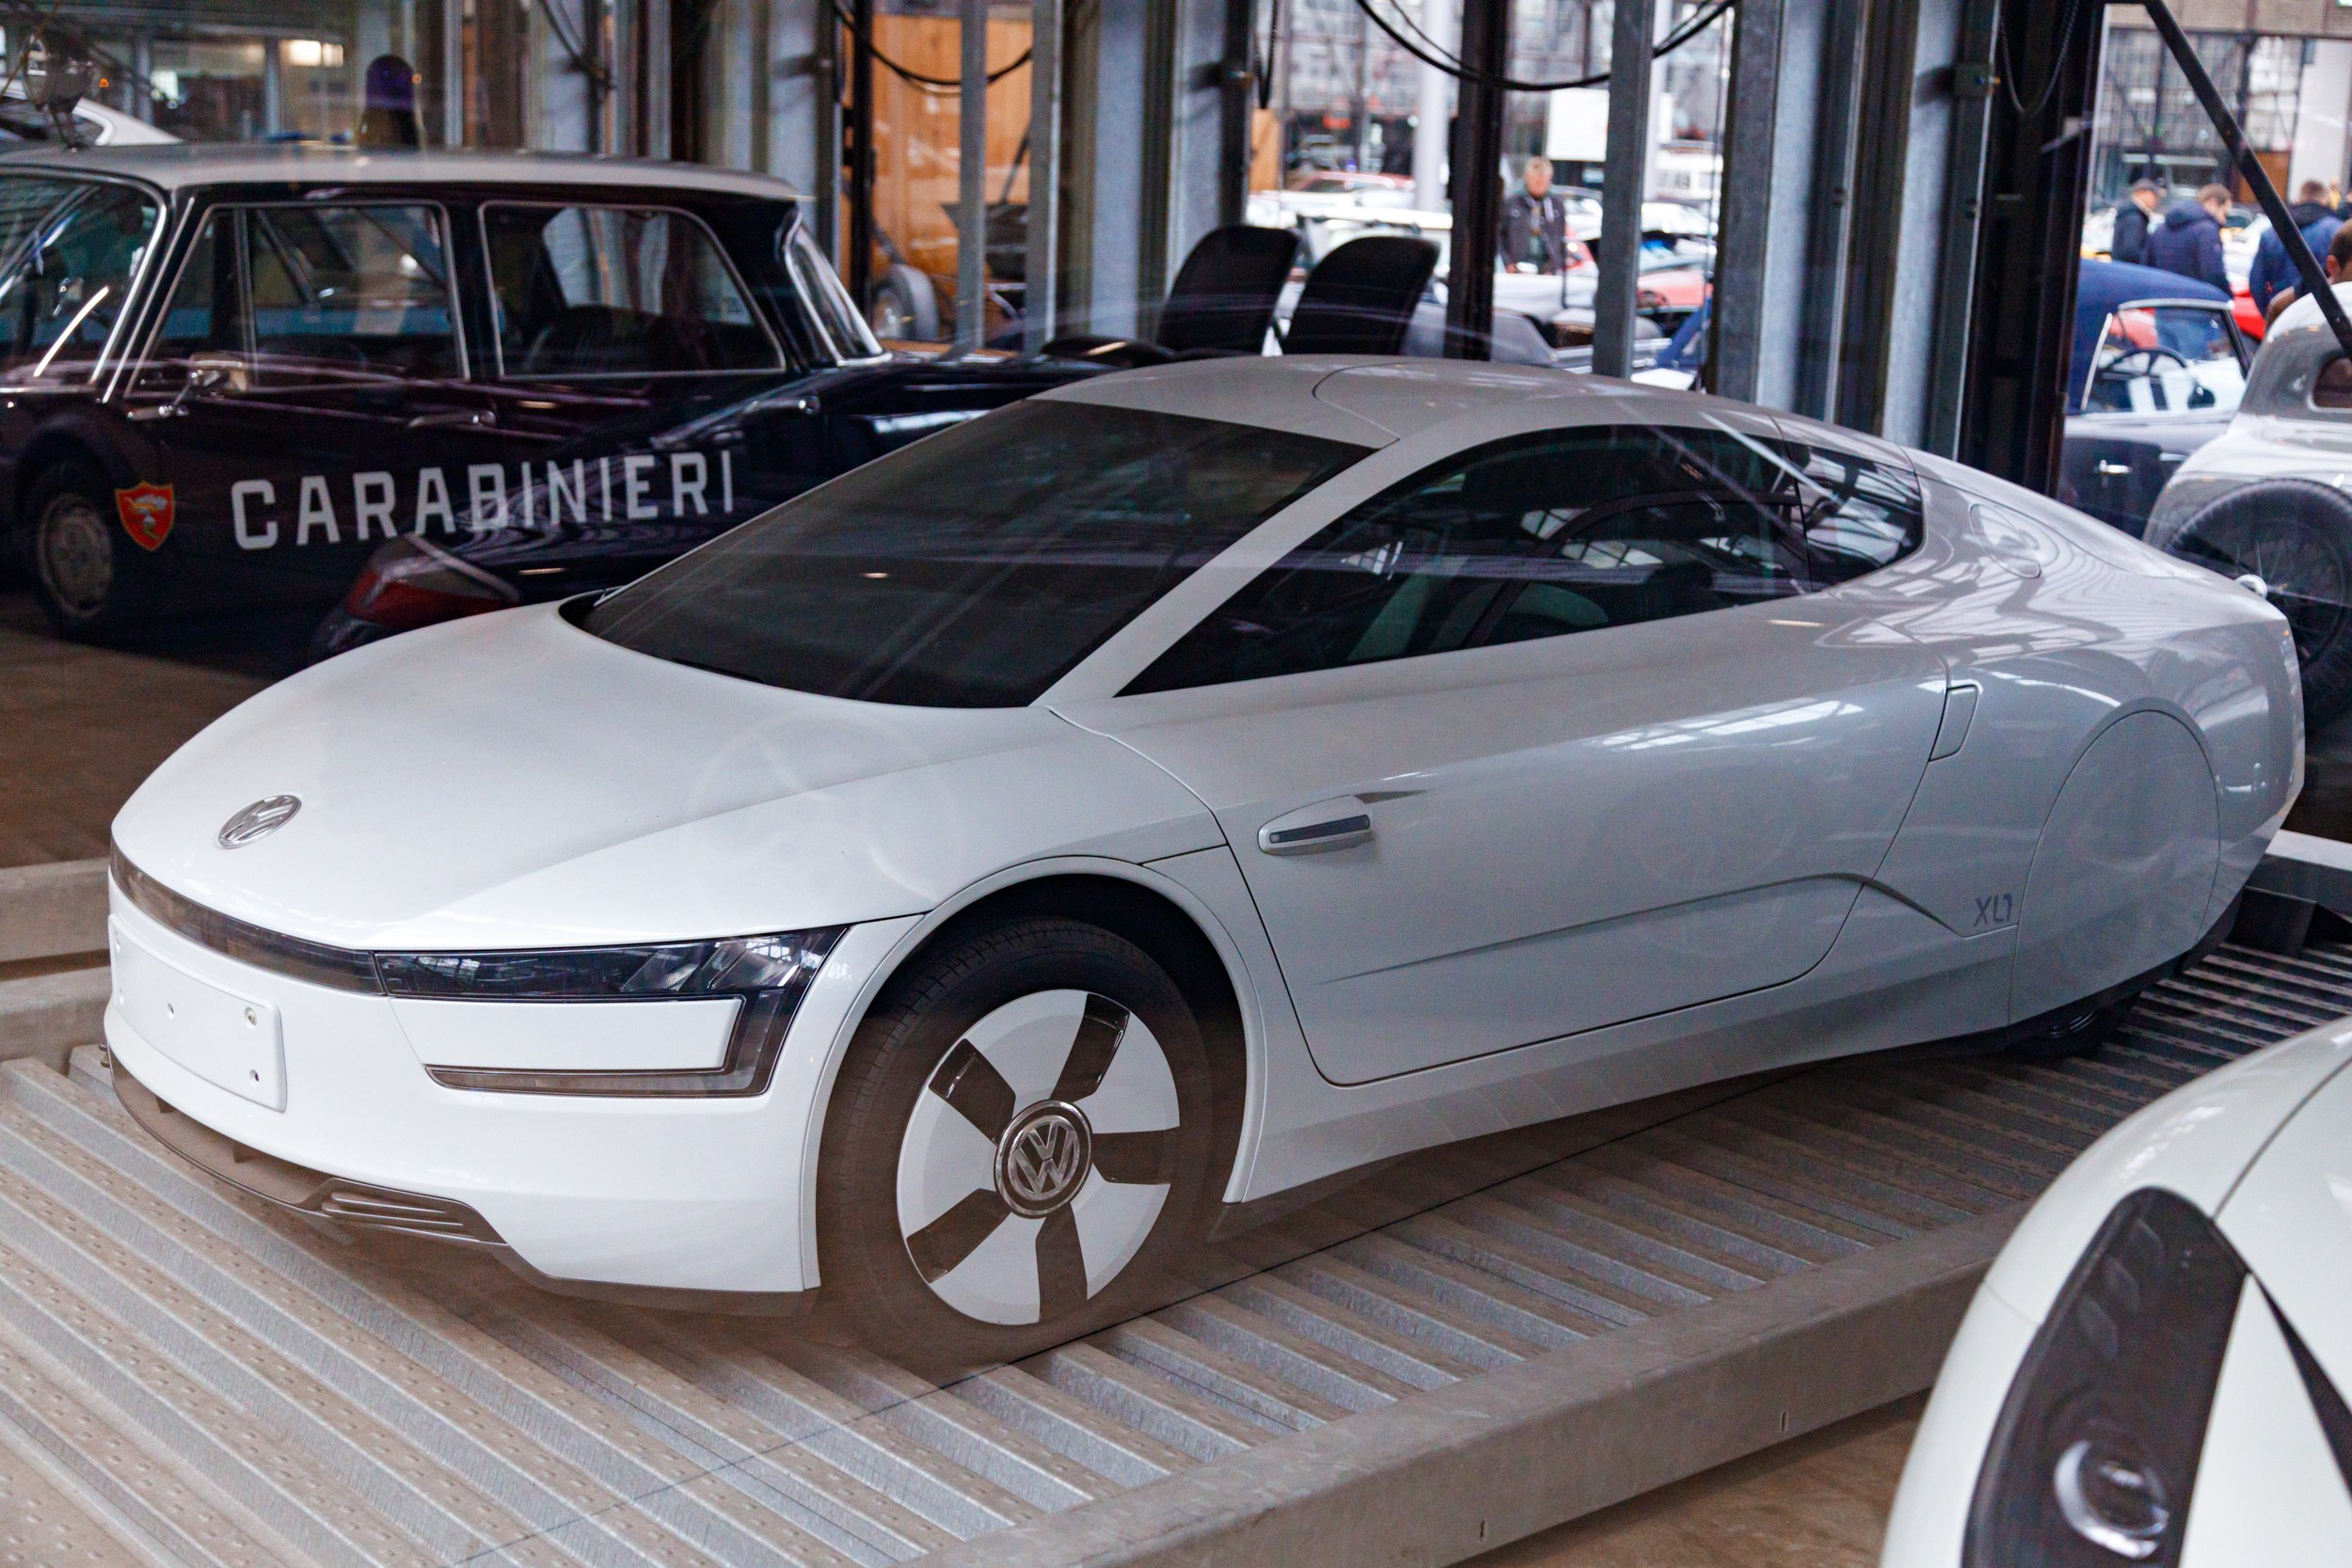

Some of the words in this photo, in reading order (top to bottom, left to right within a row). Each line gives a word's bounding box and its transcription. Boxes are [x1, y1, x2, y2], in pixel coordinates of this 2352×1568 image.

[230, 450, 732, 549] CARABINIERI
[1973, 894, 2012, 927] XL1
[1013, 1117, 1077, 1196] VW
